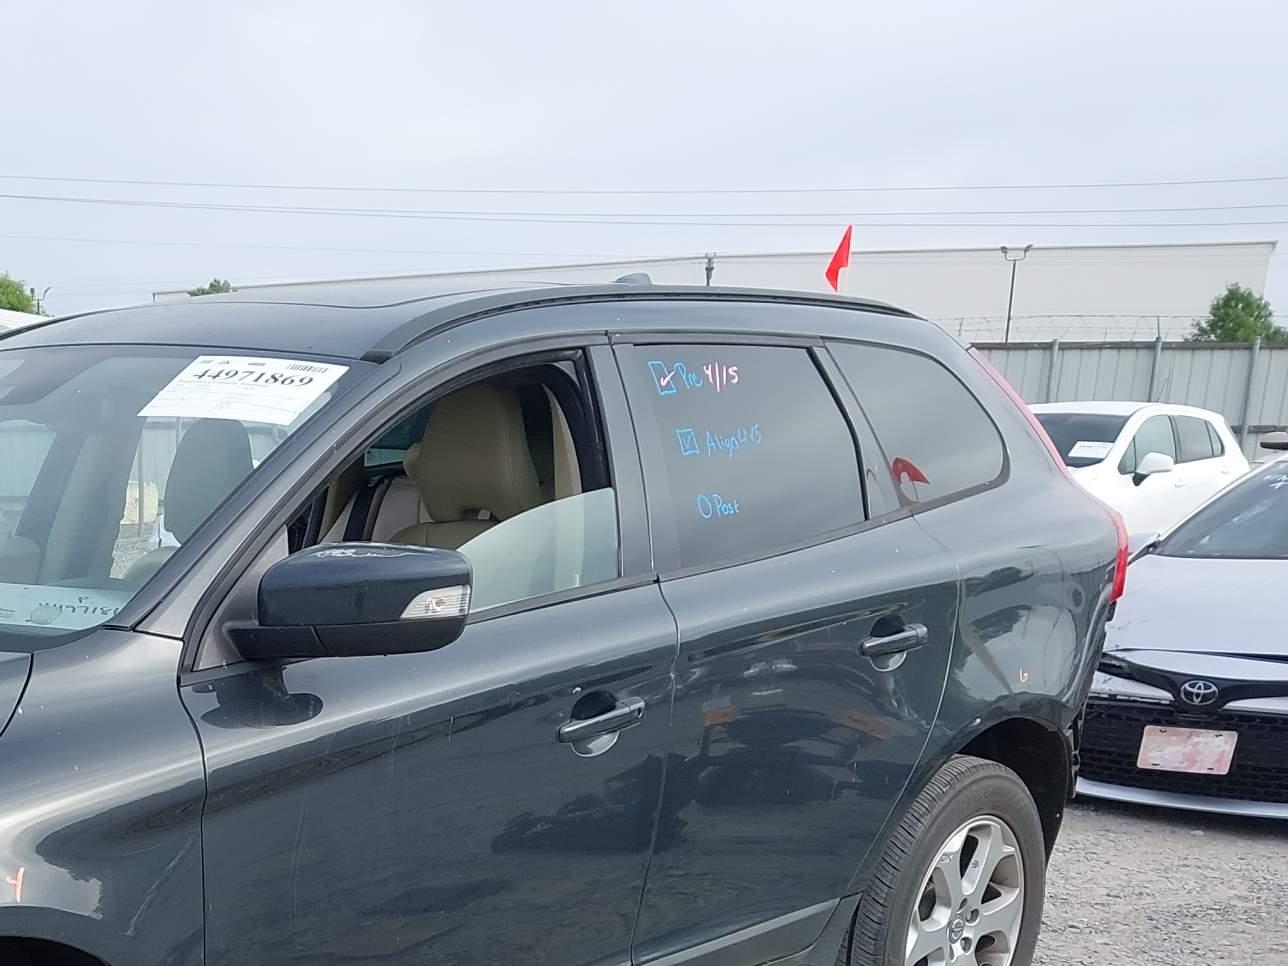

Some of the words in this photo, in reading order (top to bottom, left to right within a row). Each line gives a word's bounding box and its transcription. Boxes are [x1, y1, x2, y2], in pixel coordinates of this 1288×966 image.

[193, 368, 314, 387] 44971869
[674, 362, 703, 389] Pre
[703, 361, 740, 392] 4/15
[712, 493, 740, 517] Post
